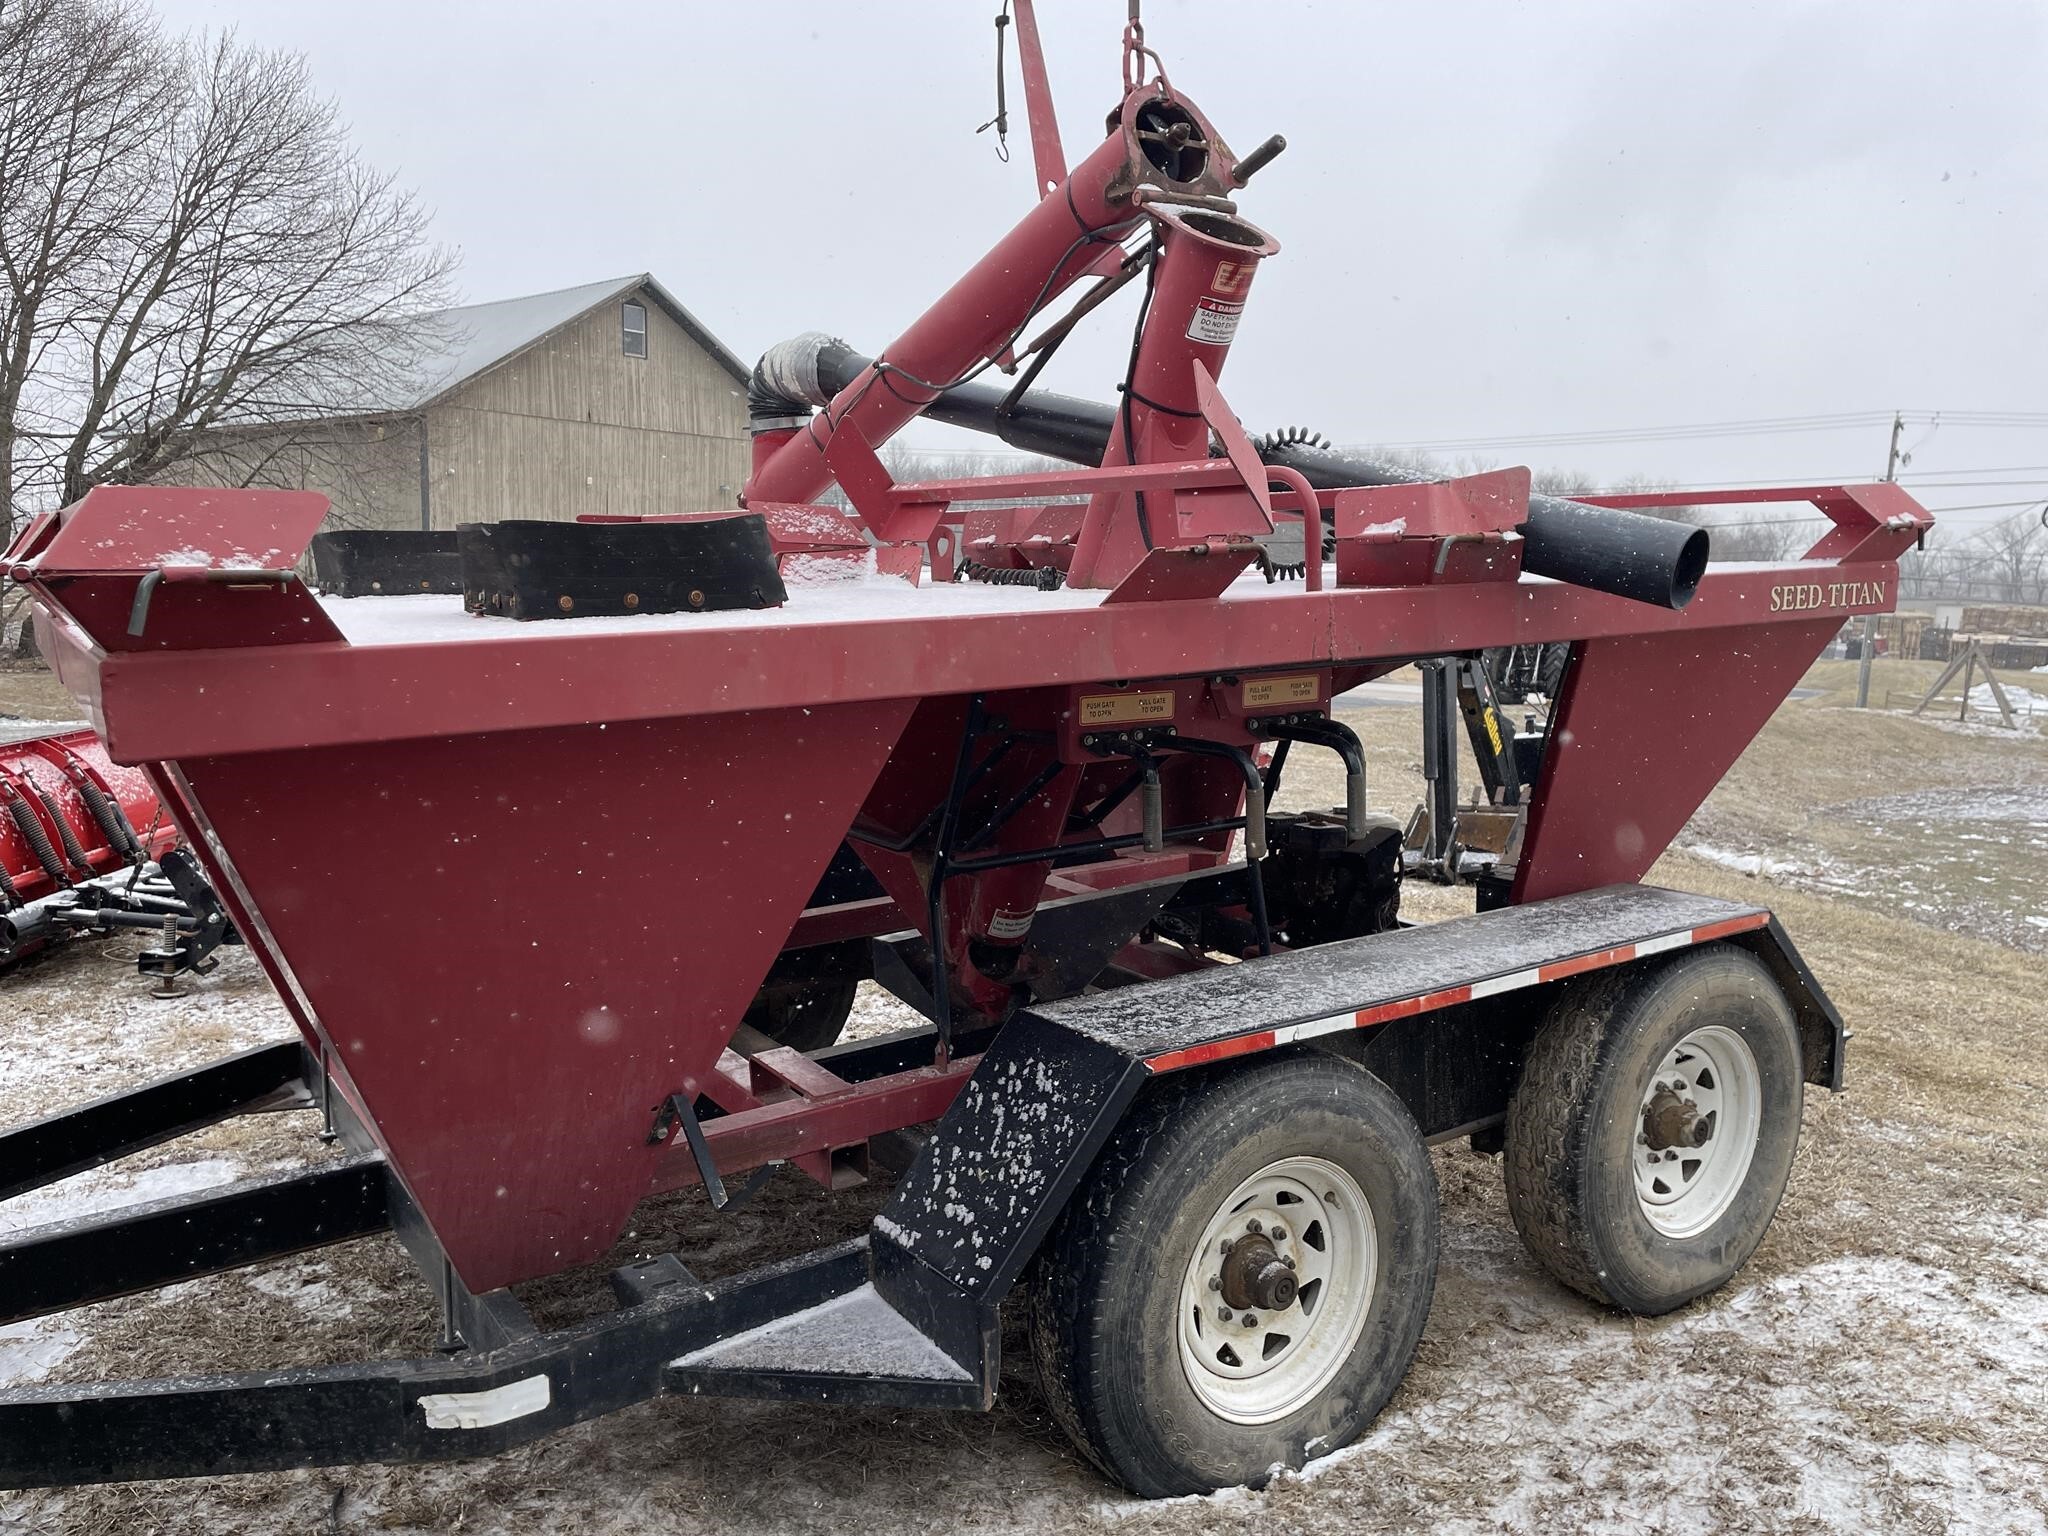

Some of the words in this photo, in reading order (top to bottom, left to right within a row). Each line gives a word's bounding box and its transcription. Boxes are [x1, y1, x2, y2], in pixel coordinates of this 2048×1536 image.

[1201, 310, 1225, 321] SAFETY
[1200, 318, 1211, 326] DO
[1770, 584, 1823, 613] SEED
[1828, 581, 1886, 609] TITAN
[1150, 705, 1164, 713] OPEN
